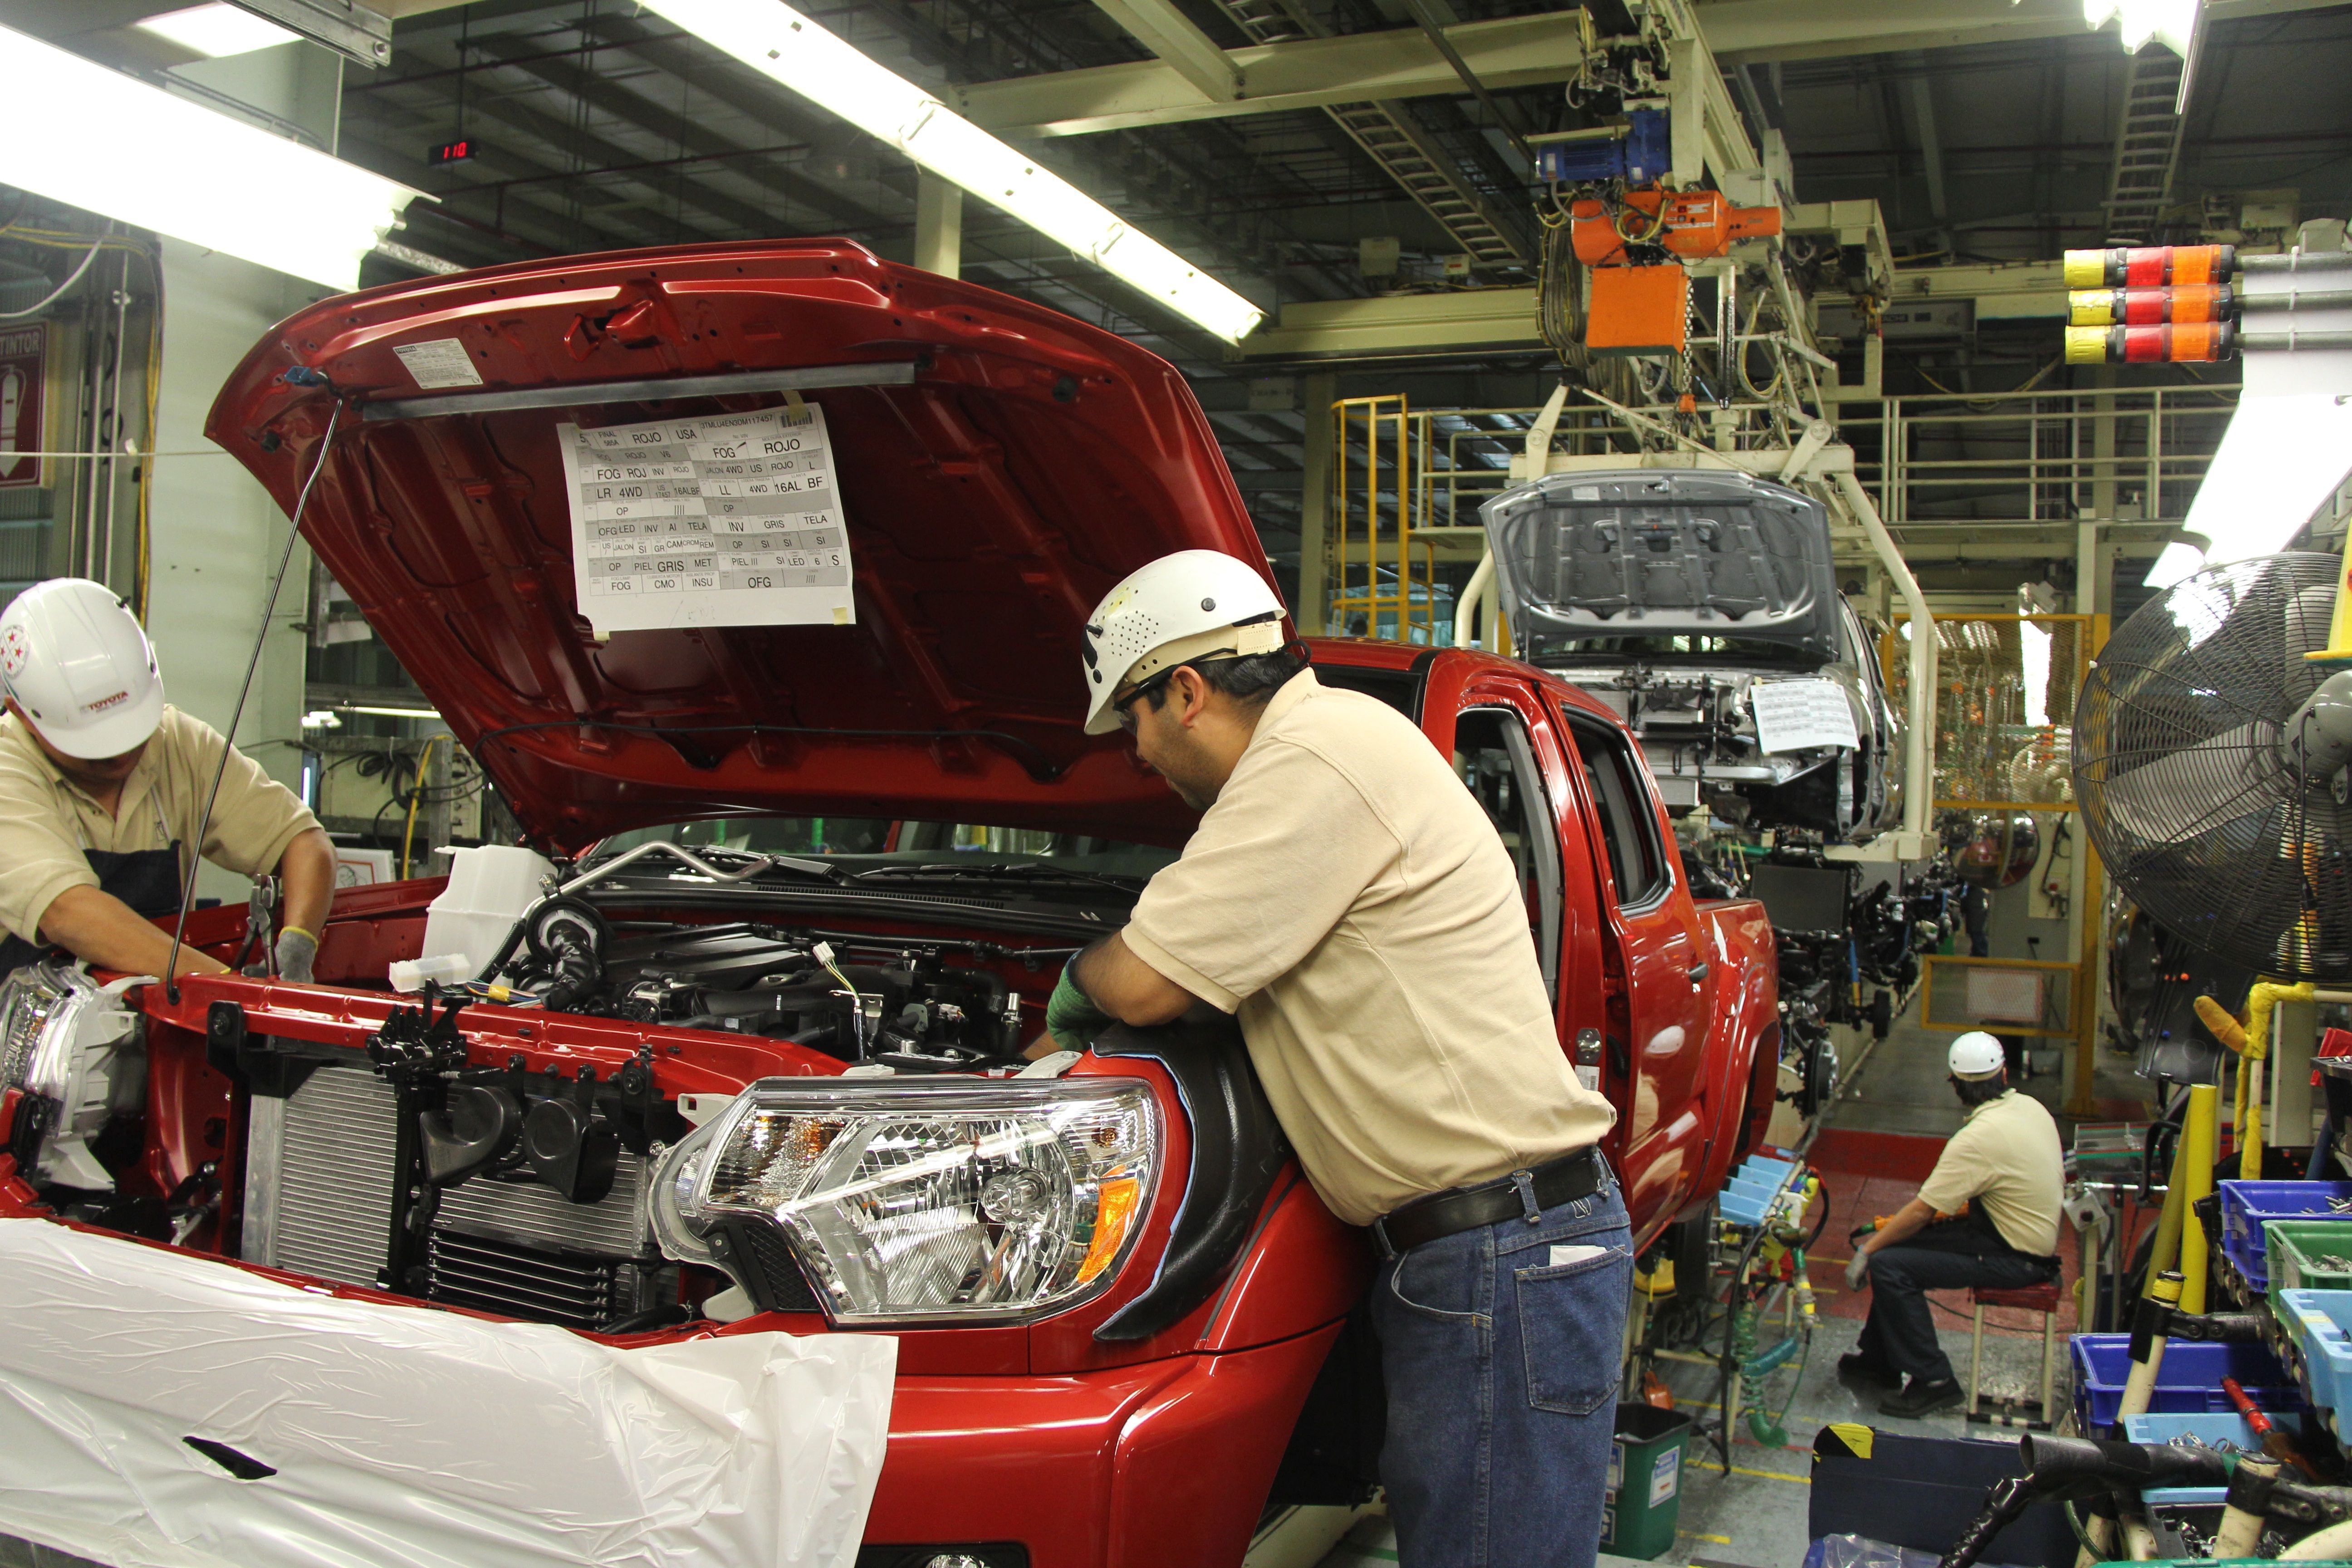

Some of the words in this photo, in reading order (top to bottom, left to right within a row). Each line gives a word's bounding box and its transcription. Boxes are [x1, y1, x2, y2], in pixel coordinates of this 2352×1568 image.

[443, 141, 467, 160] 110
[632, 432, 662, 444] ROJO
[676, 429, 697, 440] USA
[764, 439, 800, 454] ROJO
[713, 447, 736, 458] FOG
[750, 464, 762, 473] US
[771, 461, 793, 471] ROJO
[809, 461, 815, 470] L
[597, 469, 621, 480] FOG
[627, 468, 647, 478] ROJ
[652, 467, 664, 476] INV
[750, 485, 768, 493] 4WD
[775, 480, 802, 493] 16AL
[807, 476, 823, 488] BF
[597, 488, 611, 499] LR
[619, 486, 642, 498] 4WD
[674, 487, 700, 495] 16ALBF
[719, 485, 731, 495] LL
[616, 507, 628, 515] OP
[764, 520, 785, 529] GRIS
[803, 515, 828, 525] TELA
[619, 524, 635, 533] LED
[644, 524, 658, 533] INV
[669, 523, 676, 531] AI
[688, 522, 707, 530] TELA
[728, 521, 744, 532] INV
[599, 527, 617, 536] OFG
[666, 540, 683, 549] CAM
[761, 540, 770, 548] SI
[783, 539, 792, 547] SI
[816, 536, 826, 545] SI
[639, 545, 647, 554] SI
[695, 559, 712, 567] MET
[731, 558, 749, 566] PIEL
[776, 556, 785, 564] SI
[788, 558, 804, 566] LED
[832, 555, 839, 566] S
[609, 563, 621, 571] OP
[634, 562, 652, 571] PIEL
[657, 561, 684, 572] GRIS
[611, 581, 631, 590] FOG
[654, 579, 675, 588] CMO
[692, 578, 713, 587] INSU
[748, 577, 771, 588] OFG
[88, 691, 129, 710] TOYOTA
